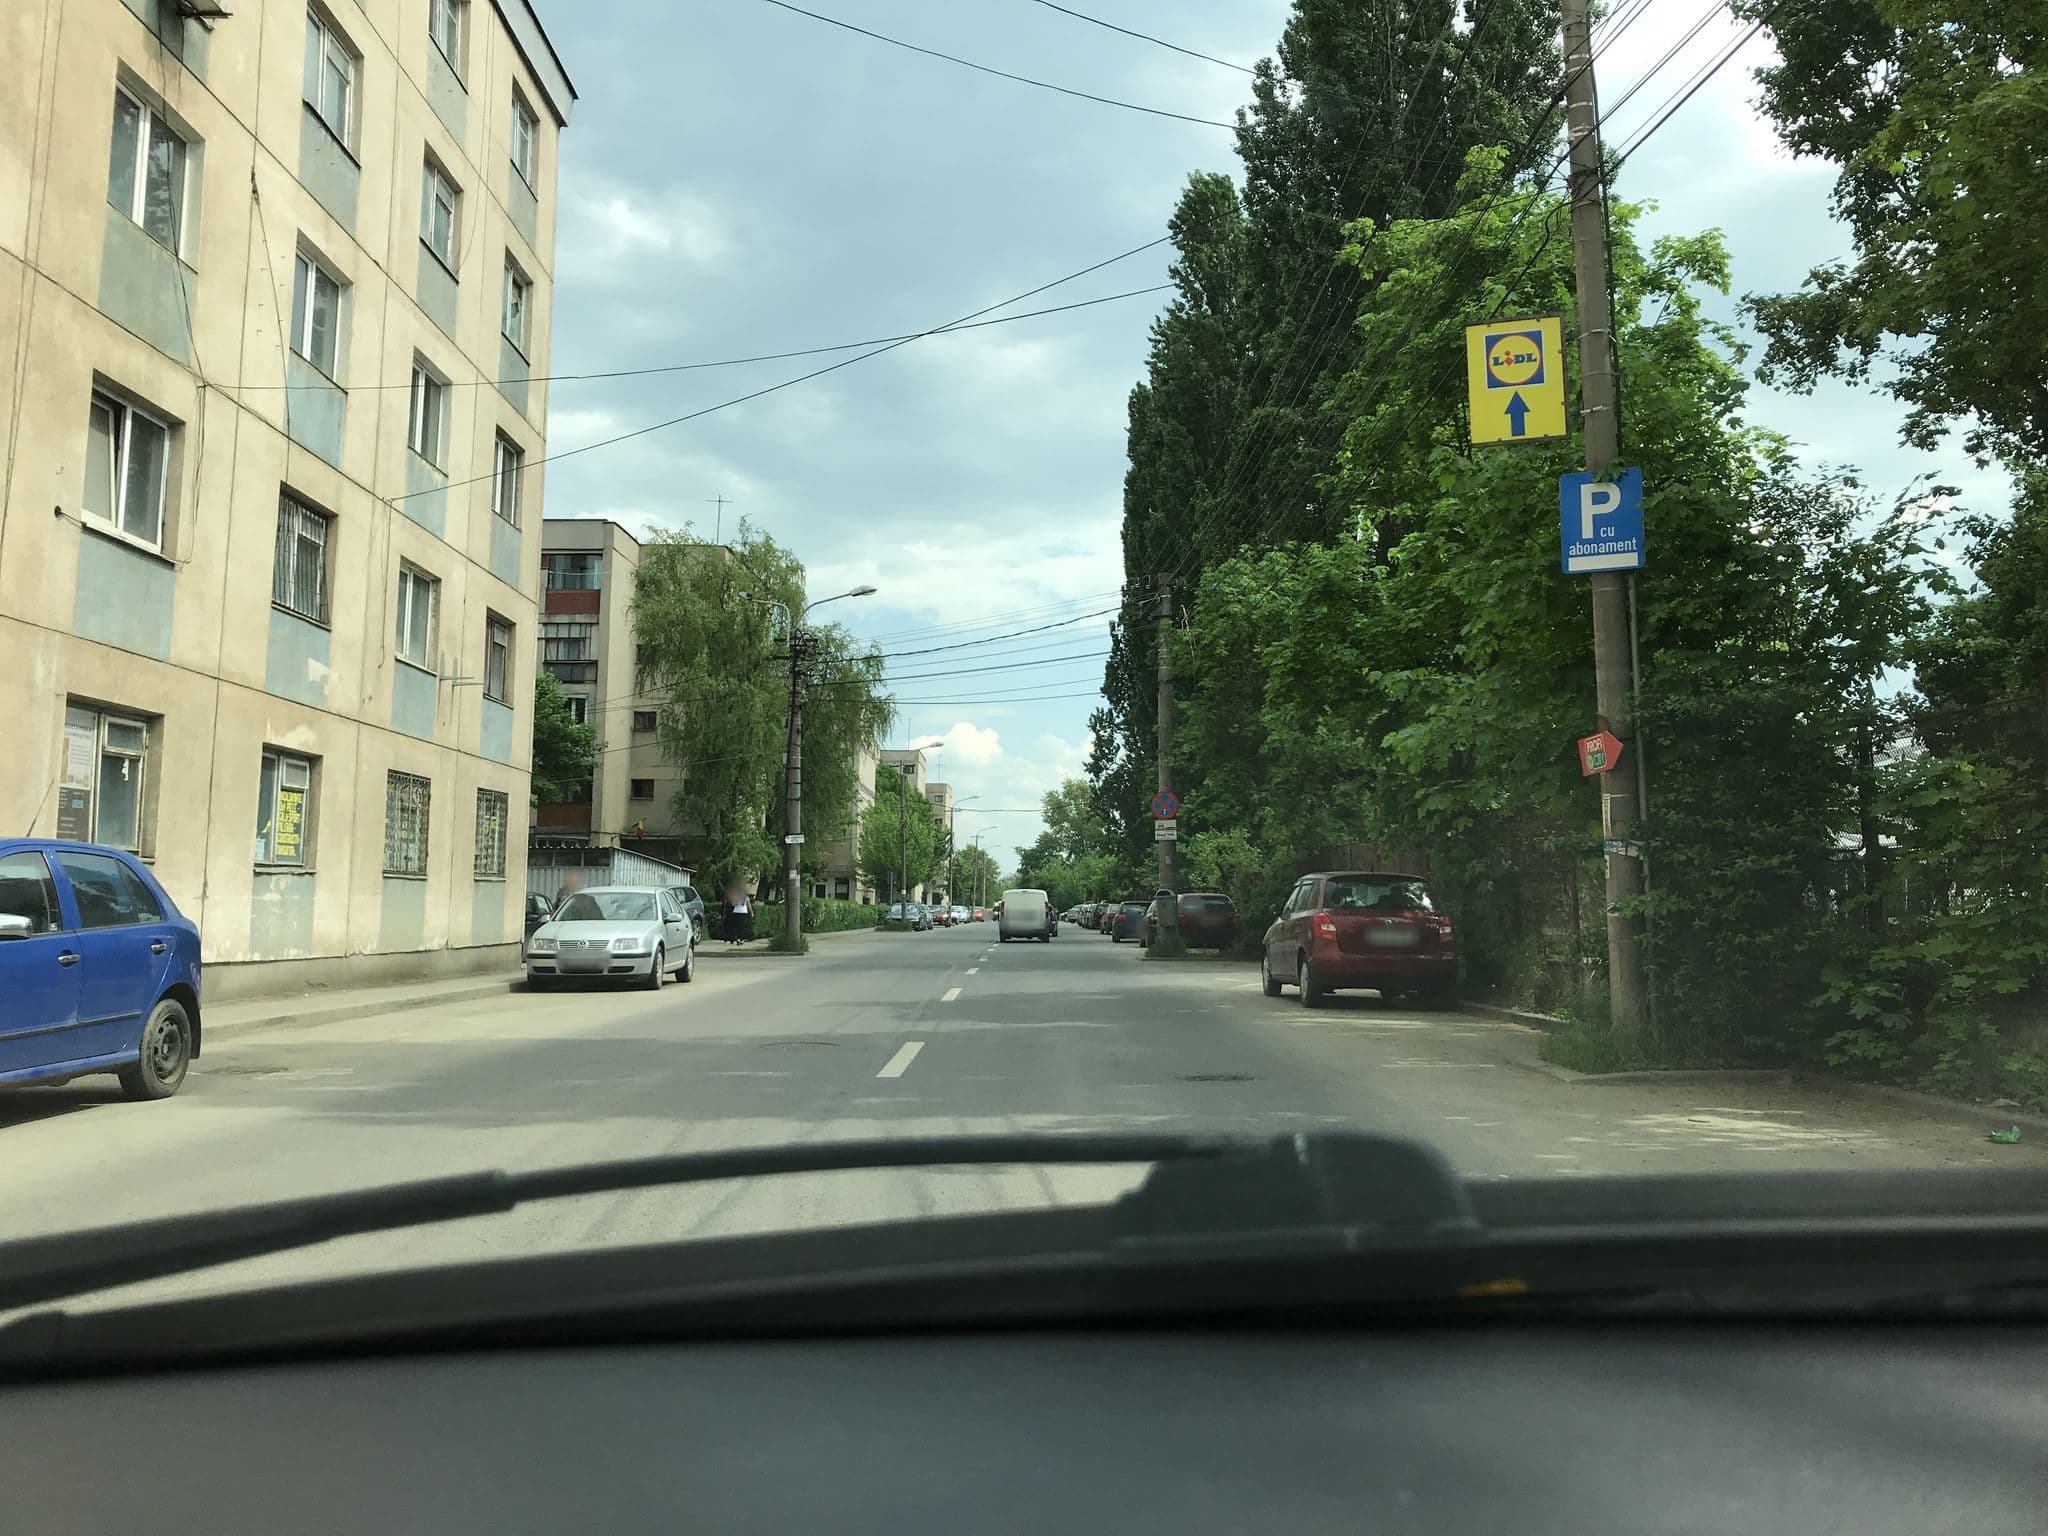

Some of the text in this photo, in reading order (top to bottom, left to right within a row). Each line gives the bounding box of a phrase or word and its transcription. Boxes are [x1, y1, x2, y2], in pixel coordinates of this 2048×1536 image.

[1581, 482, 1621, 539] P
[1600, 526, 1615, 537] cu
[1569, 537, 1637, 556] abonament
